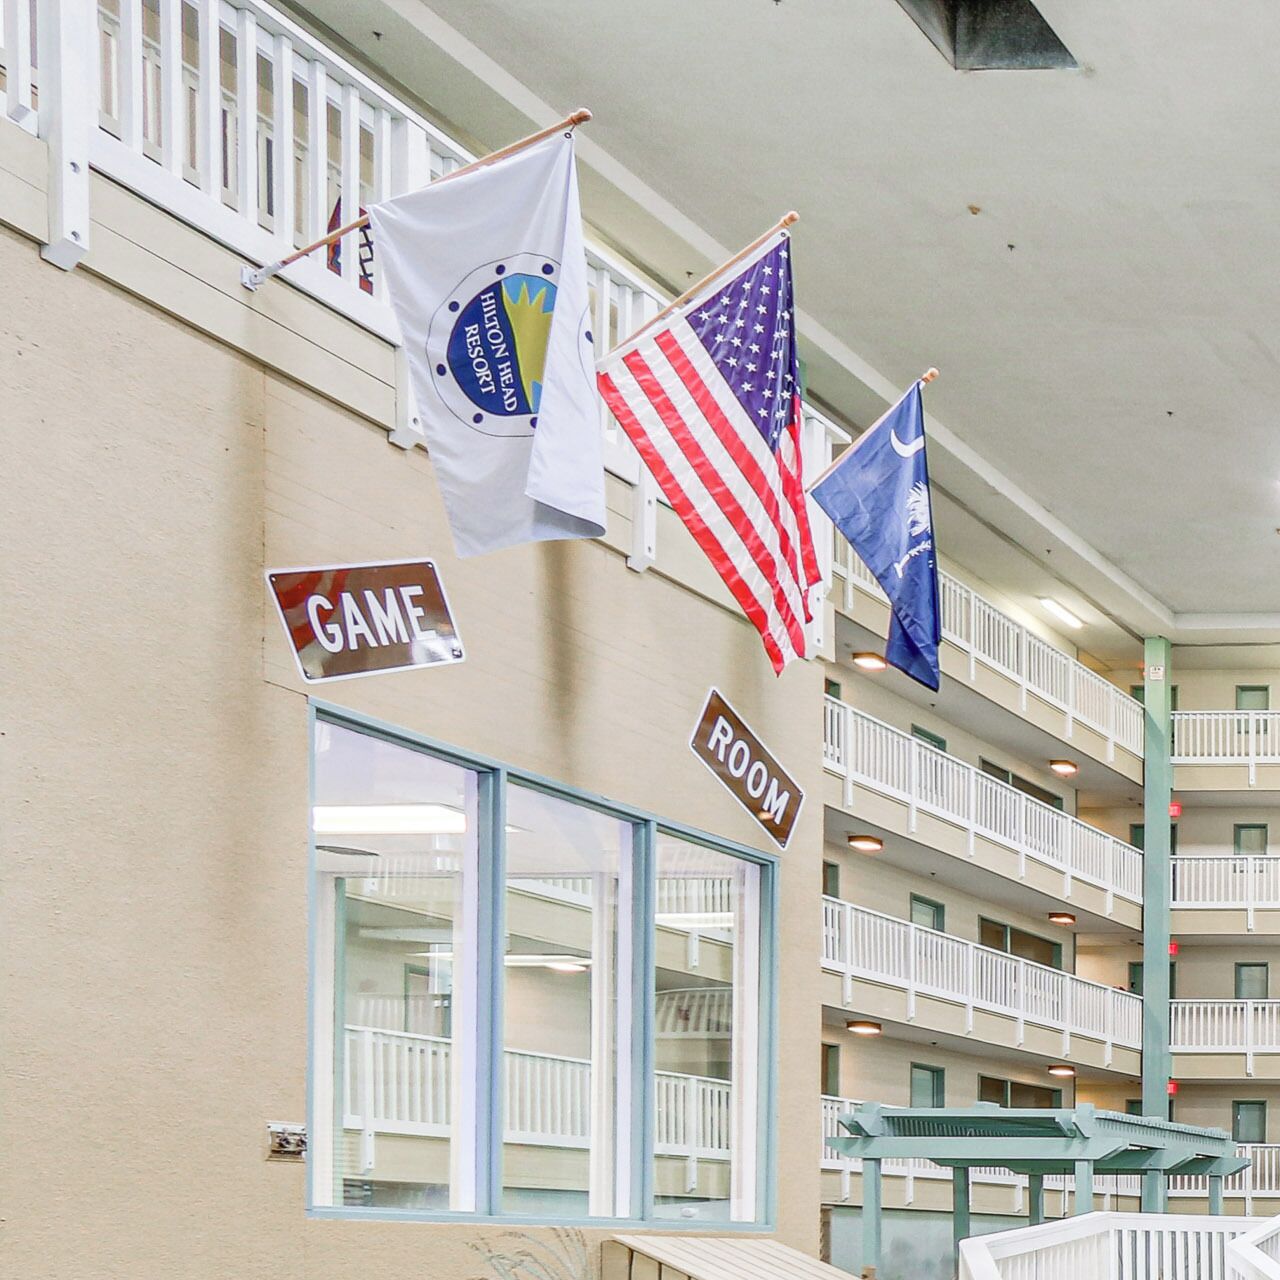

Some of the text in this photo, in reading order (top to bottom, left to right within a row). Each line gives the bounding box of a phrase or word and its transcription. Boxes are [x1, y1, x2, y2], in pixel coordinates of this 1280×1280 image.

[464, 323, 496, 394] RESORT
[480, 291, 518, 412] HILTON HEAD
[306, 585, 437, 654] GAME
[707, 715, 790, 825] ROOM
